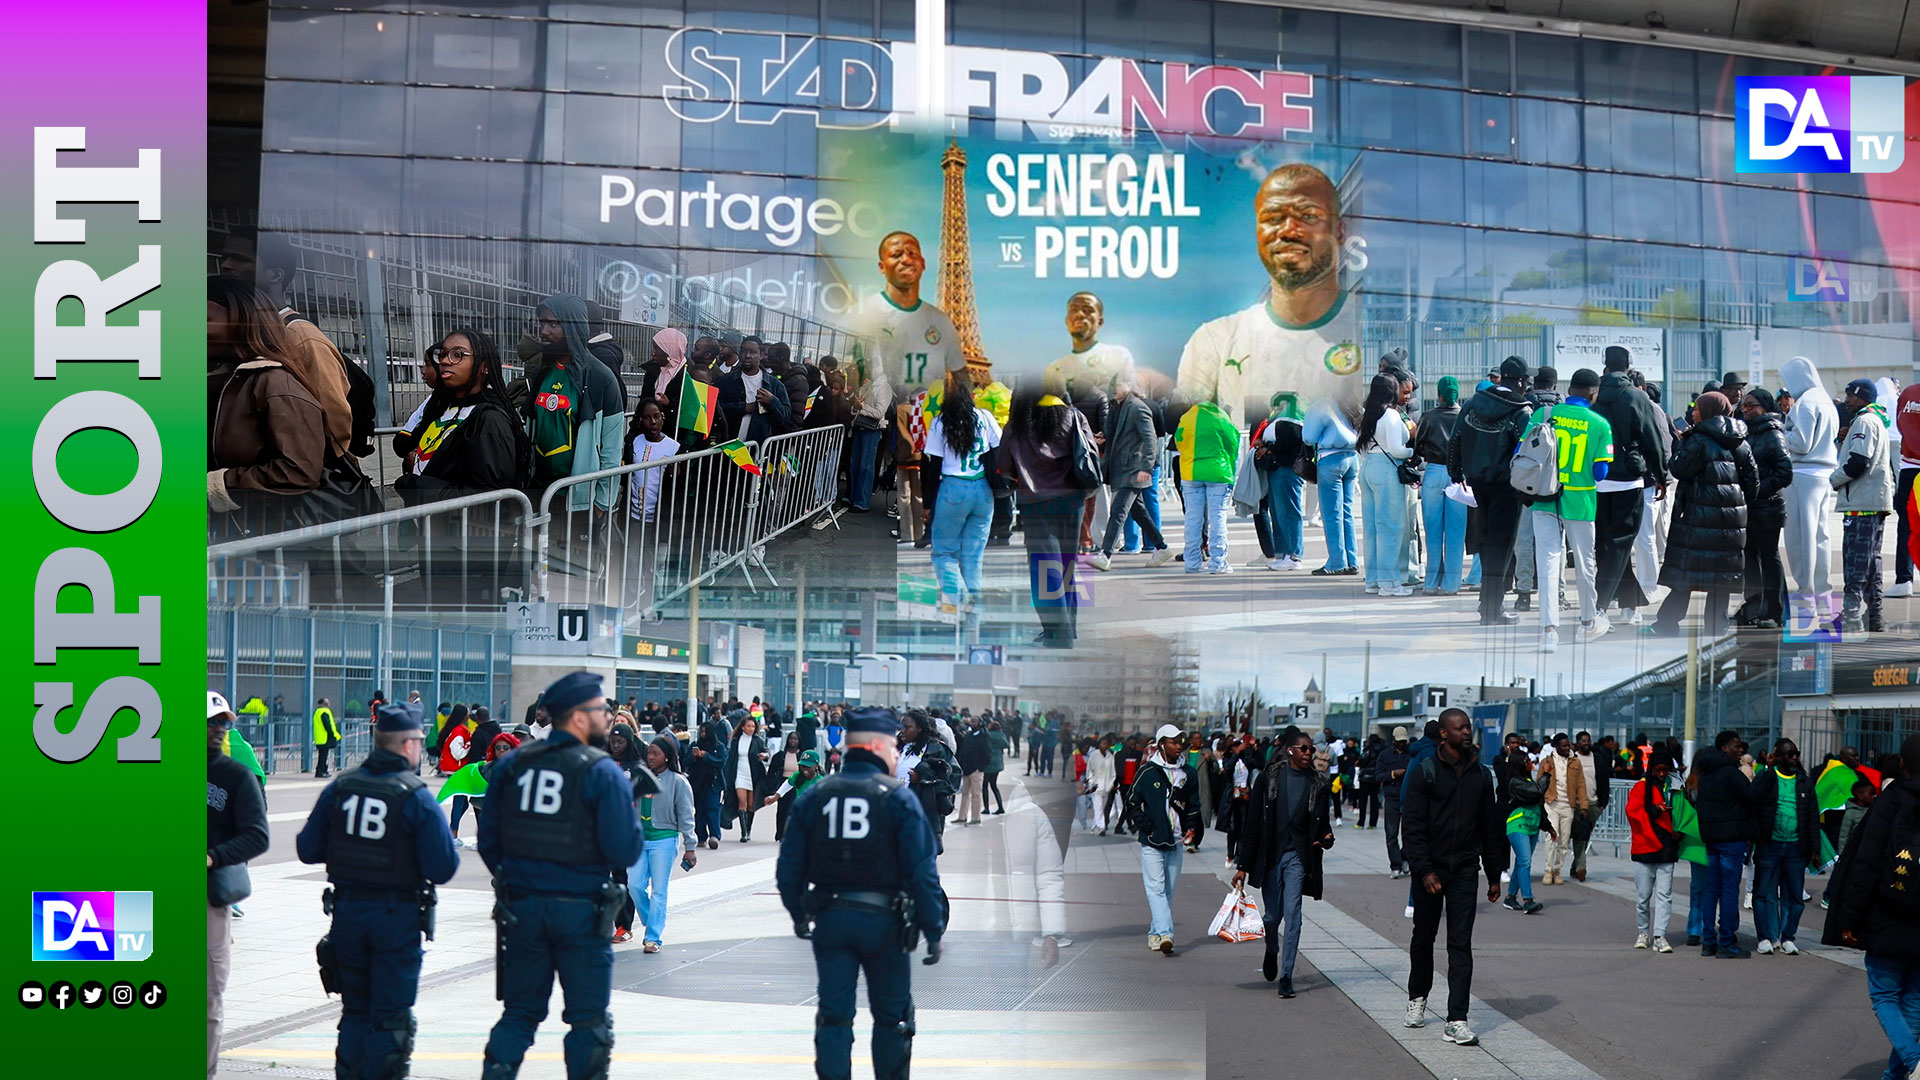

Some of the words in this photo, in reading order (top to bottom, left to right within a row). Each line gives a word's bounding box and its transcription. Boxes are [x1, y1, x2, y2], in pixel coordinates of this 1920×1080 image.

[986, 153, 1200, 217] SENEGAL
[1001, 242, 1022, 262] VS
[1035, 225, 1179, 279] PEROU
[905, 352, 928, 383] 17
[563, 615, 583, 641] U
[1297, 707, 1306, 719] S
[1431, 691, 1444, 708] T
[517, 768, 564, 815] 1B
[342, 794, 388, 841] 1B
[822, 796, 870, 839] 1B
